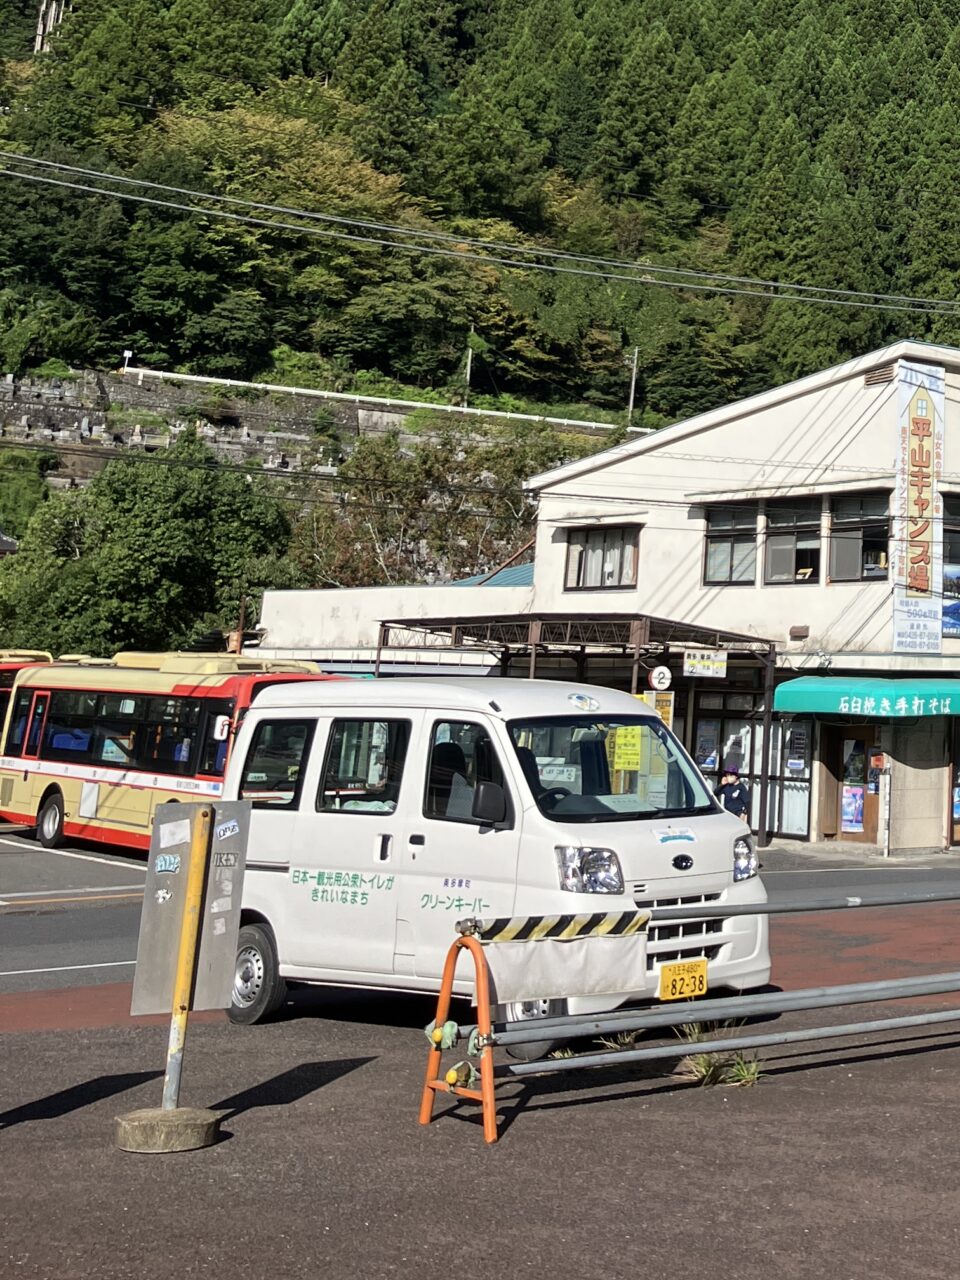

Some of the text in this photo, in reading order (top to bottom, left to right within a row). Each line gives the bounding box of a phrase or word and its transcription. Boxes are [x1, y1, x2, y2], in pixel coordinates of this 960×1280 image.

[657, 671, 666, 685] 2
[838, 696, 952, 715] 石臼挽き手打そば
[292, 870, 394, 891] 日本一観光用公衆トイレが
[311, 888, 369, 906] きれいなまち
[671, 974, 705, 996] 82-38
